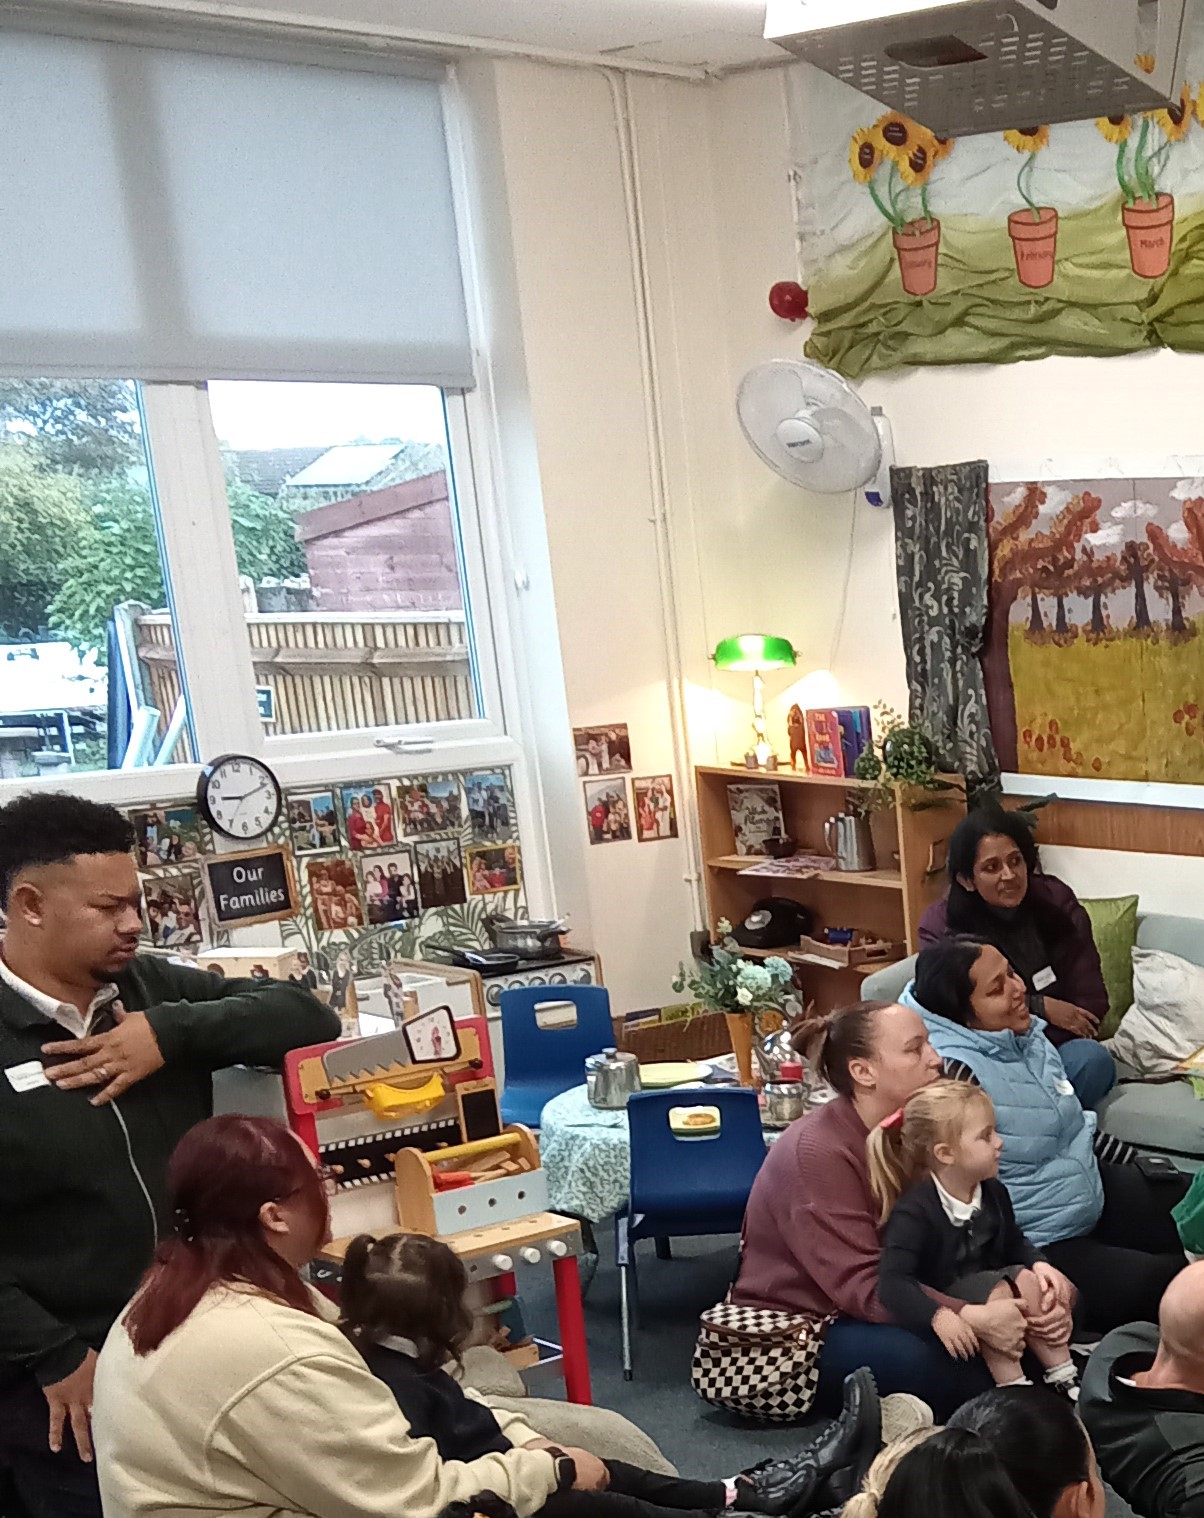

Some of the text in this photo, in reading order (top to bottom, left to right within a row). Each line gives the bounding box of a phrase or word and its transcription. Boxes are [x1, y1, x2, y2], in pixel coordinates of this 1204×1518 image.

[1139, 237, 1165, 249] March
[220, 768, 227, 778] 11
[231, 763, 240, 773] 12
[211, 779, 221, 789] 10
[264, 790, 272, 799] 3
[209, 795, 216, 805] 9
[263, 806, 270, 815] 4
[228, 818, 234, 829] 7
[254, 816, 261, 826] 5
[241, 821, 248, 832] 6
[233, 866, 264, 883] Our
[219, 887, 285, 911] Families
